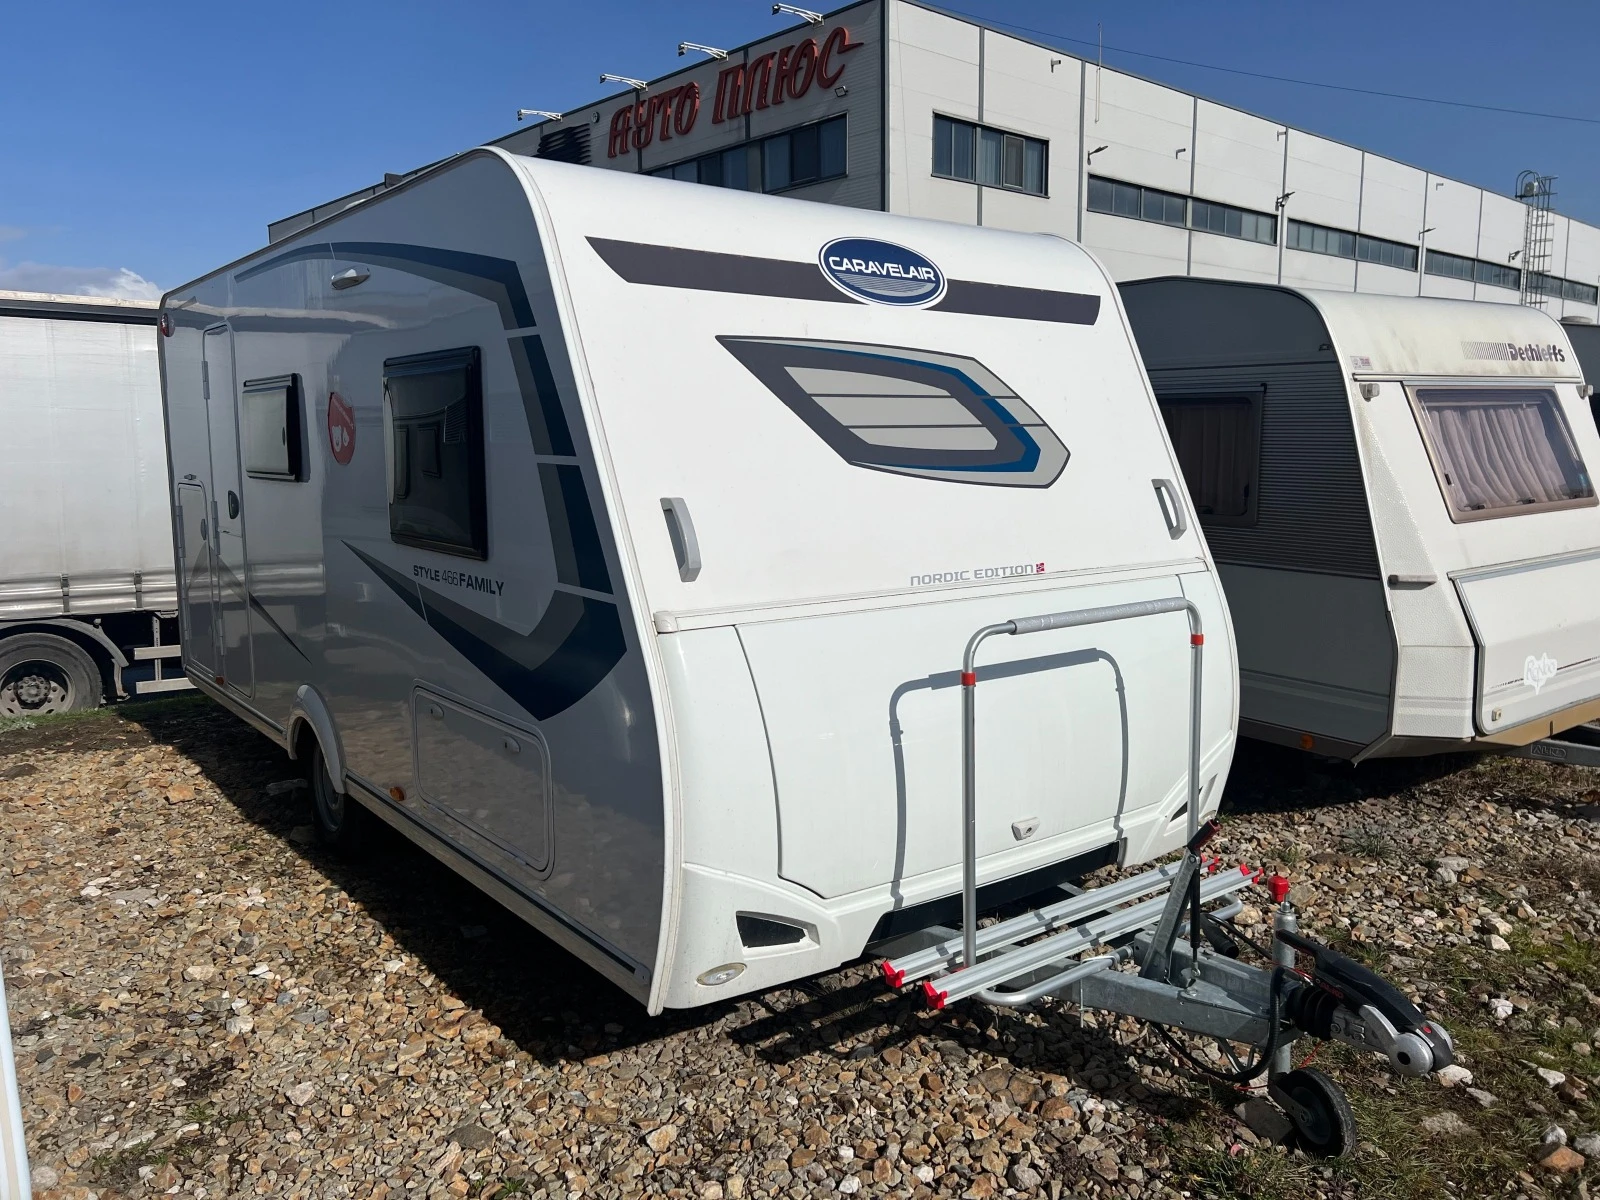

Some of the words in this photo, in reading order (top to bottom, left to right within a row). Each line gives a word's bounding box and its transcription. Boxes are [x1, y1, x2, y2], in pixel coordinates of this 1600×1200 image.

[607, 81, 699, 158] АУТО
[712, 27, 864, 124] ПЛЮС
[829, 257, 936, 281] CARAVELAIR
[1507, 343, 1566, 363] Dethleffs
[413, 565, 440, 582] STYLE
[459, 573, 504, 596] FAMILY
[910, 571, 970, 586] NORDIC
[974, 564, 1034, 579] EDITION
